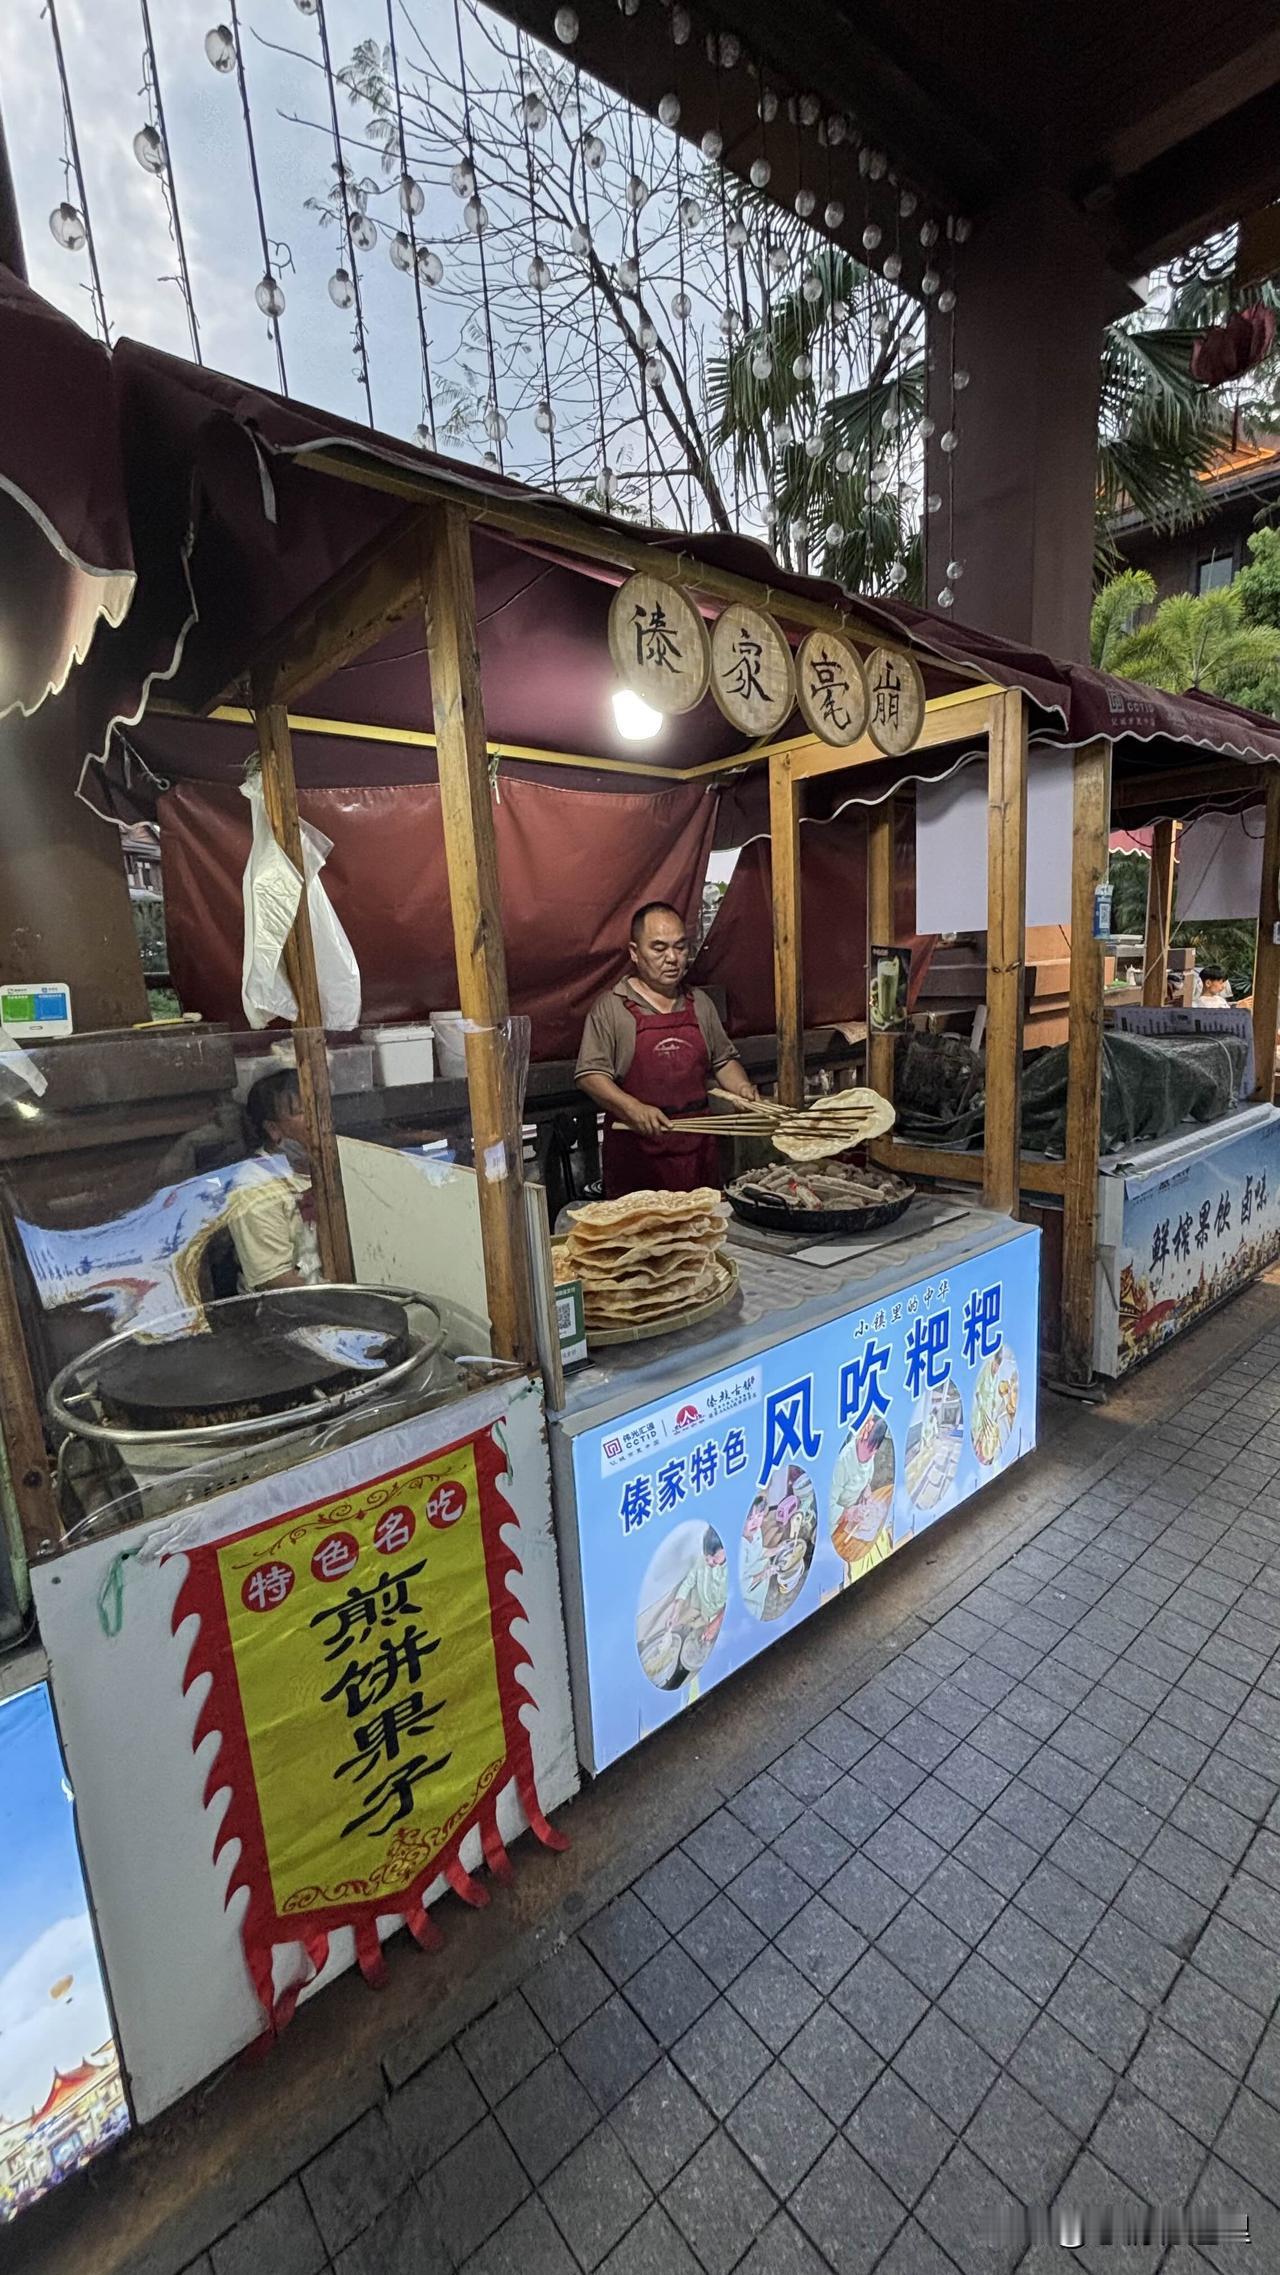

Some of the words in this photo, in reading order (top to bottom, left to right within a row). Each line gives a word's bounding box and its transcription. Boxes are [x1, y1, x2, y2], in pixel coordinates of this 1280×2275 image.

[854, 1280, 949, 1337] 小镇里的中华
[626, 1430, 657, 1448] CCTID
[759, 1284, 1002, 1485] 风吹粑粑
[621, 1429, 748, 1533] 傣家特色
[248, 1487, 462, 1611] 特色名吃
[309, 1557, 453, 1838] 煎饼果子
